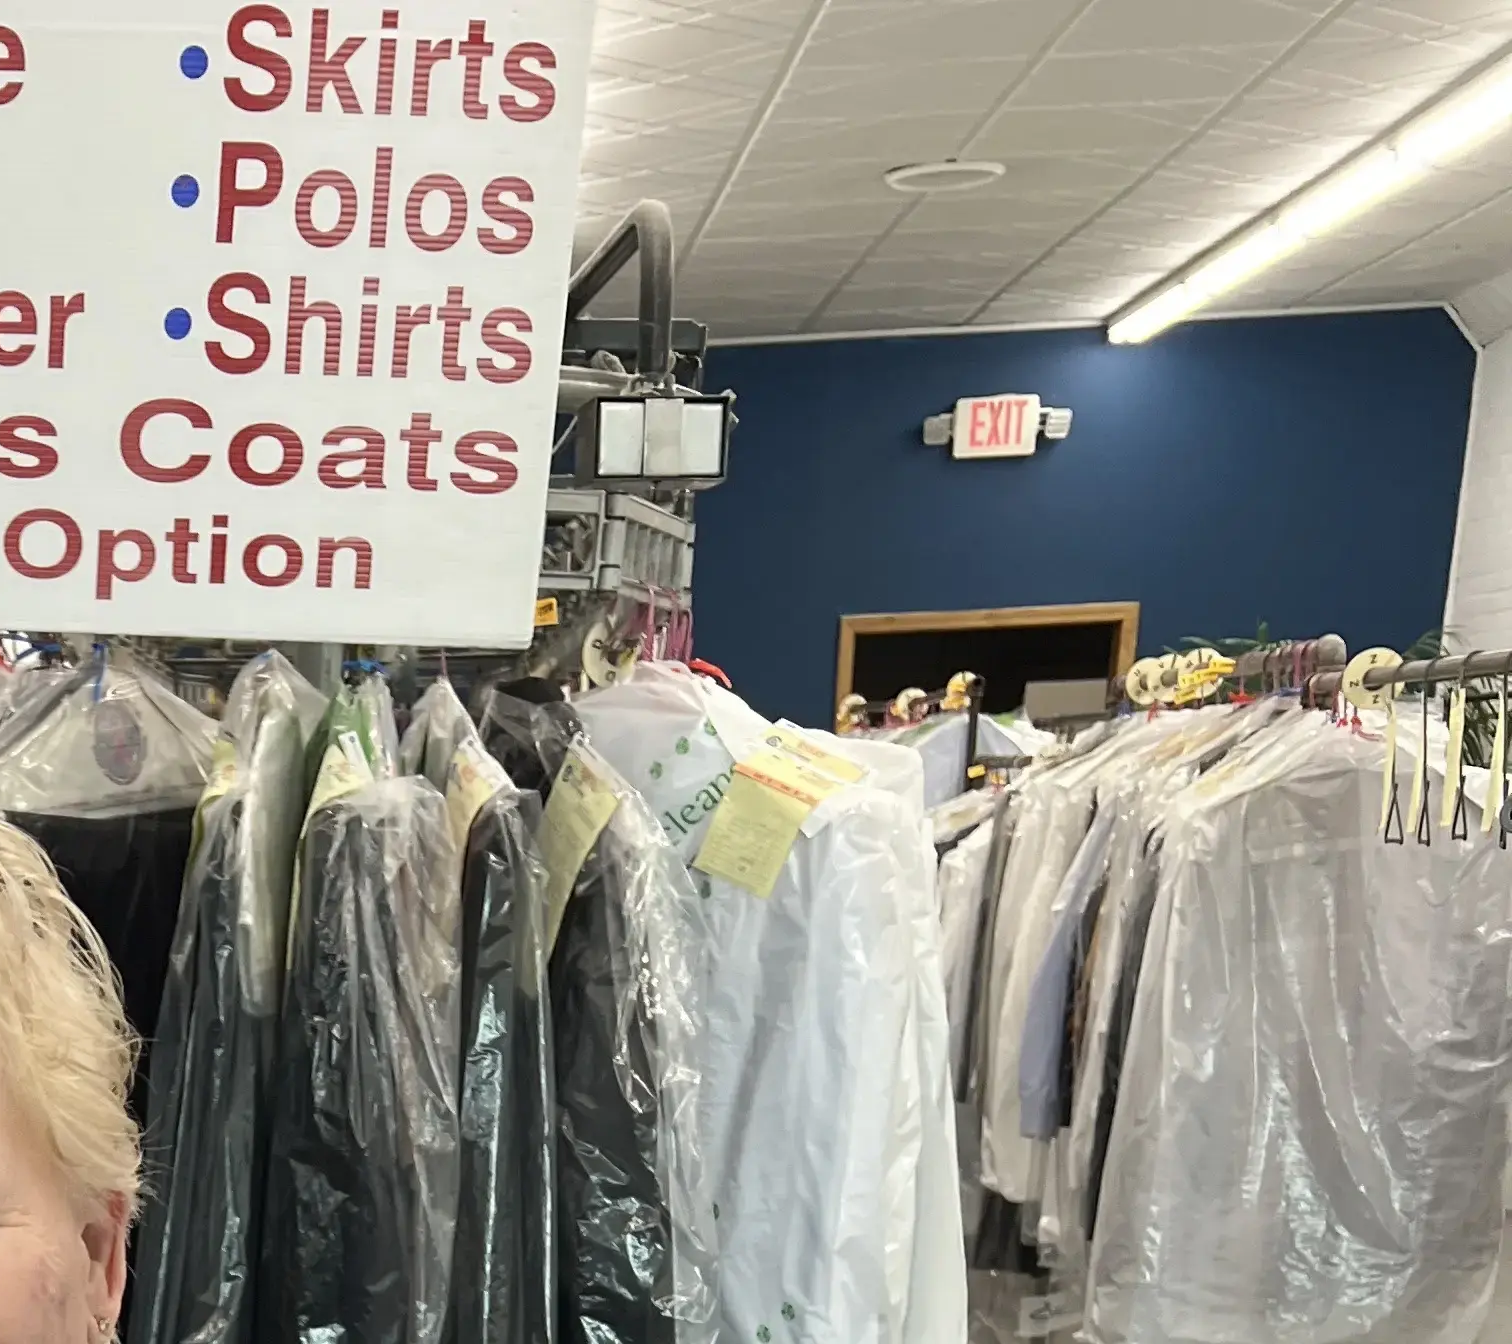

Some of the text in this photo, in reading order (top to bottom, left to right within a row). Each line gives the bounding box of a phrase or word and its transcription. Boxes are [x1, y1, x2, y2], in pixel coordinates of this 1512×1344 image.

[223, 3, 556, 123] Skirts
[215, 141, 535, 255] Polos
[205, 271, 533, 383] Shirts
[119, 397, 518, 495] Coats
[969, 400, 1029, 447] EXIT
[3, 507, 373, 600] Option
